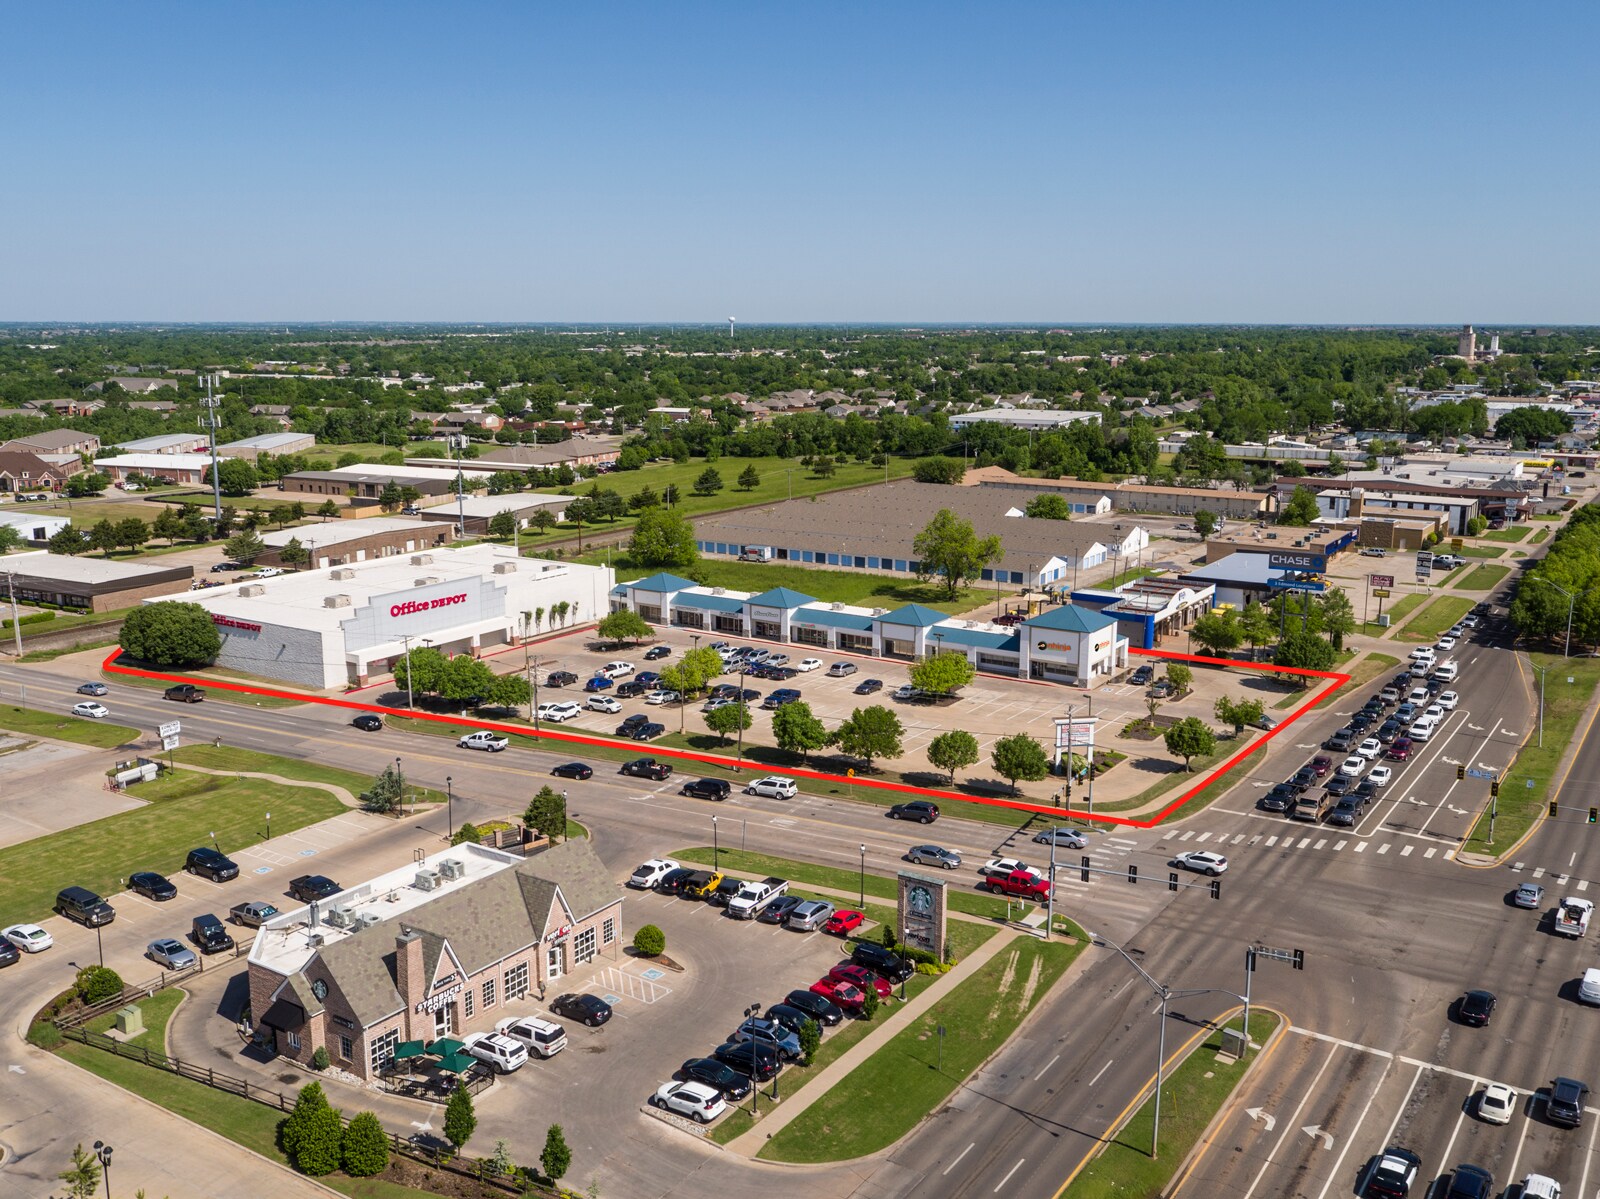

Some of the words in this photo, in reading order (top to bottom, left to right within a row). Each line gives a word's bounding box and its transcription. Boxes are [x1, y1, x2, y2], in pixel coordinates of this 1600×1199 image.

[1271, 555, 1311, 566] CHASE
[390, 601, 430, 617] Office
[431, 593, 467, 609] DEPOT
[547, 924, 571, 940] verizon
[417, 982, 465, 1012] STARBUCKS
[427, 994, 457, 1014] COFFEE
